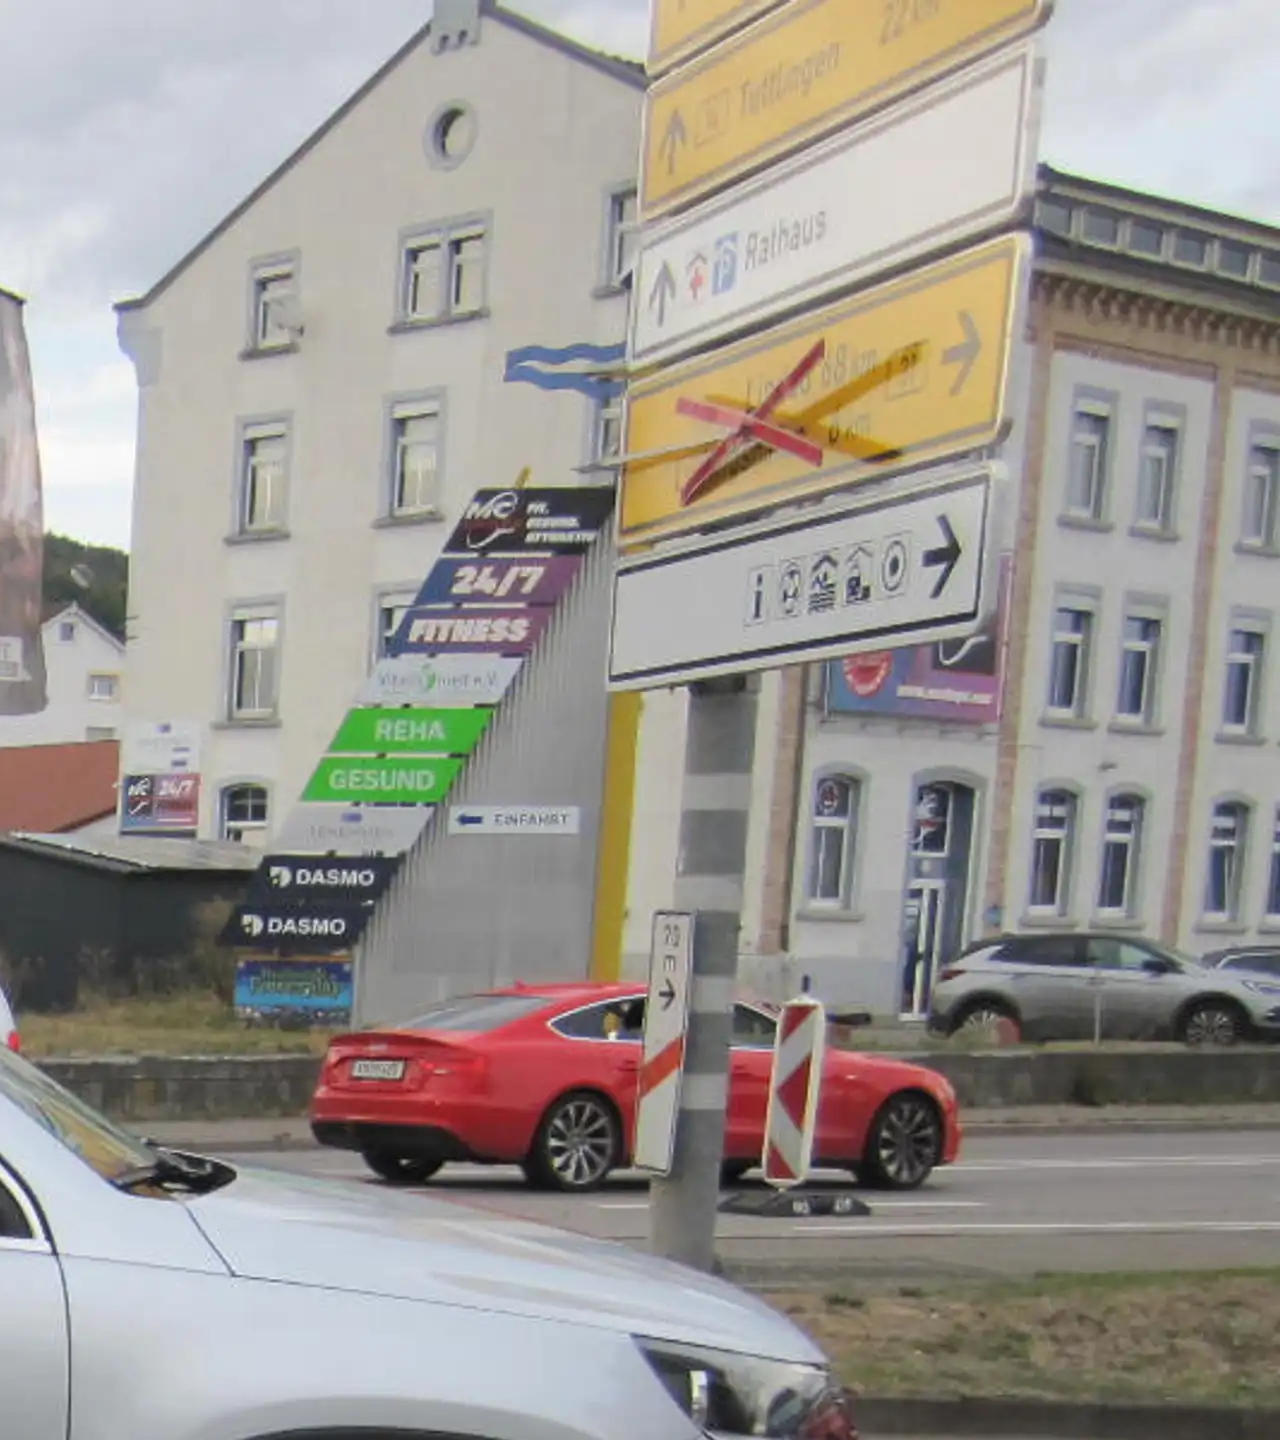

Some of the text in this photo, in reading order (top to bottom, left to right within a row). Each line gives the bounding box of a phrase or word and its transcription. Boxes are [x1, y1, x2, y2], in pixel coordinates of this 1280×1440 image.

[744, 210, 826, 271] Rathaus
[451, 566, 545, 597] 24/7
[408, 616, 530, 643] FITNESS
[374, 718, 447, 742] REHA
[328, 769, 436, 791] GESUND
[295, 868, 375, 886] DASMO
[267, 917, 346, 935] DASMO
